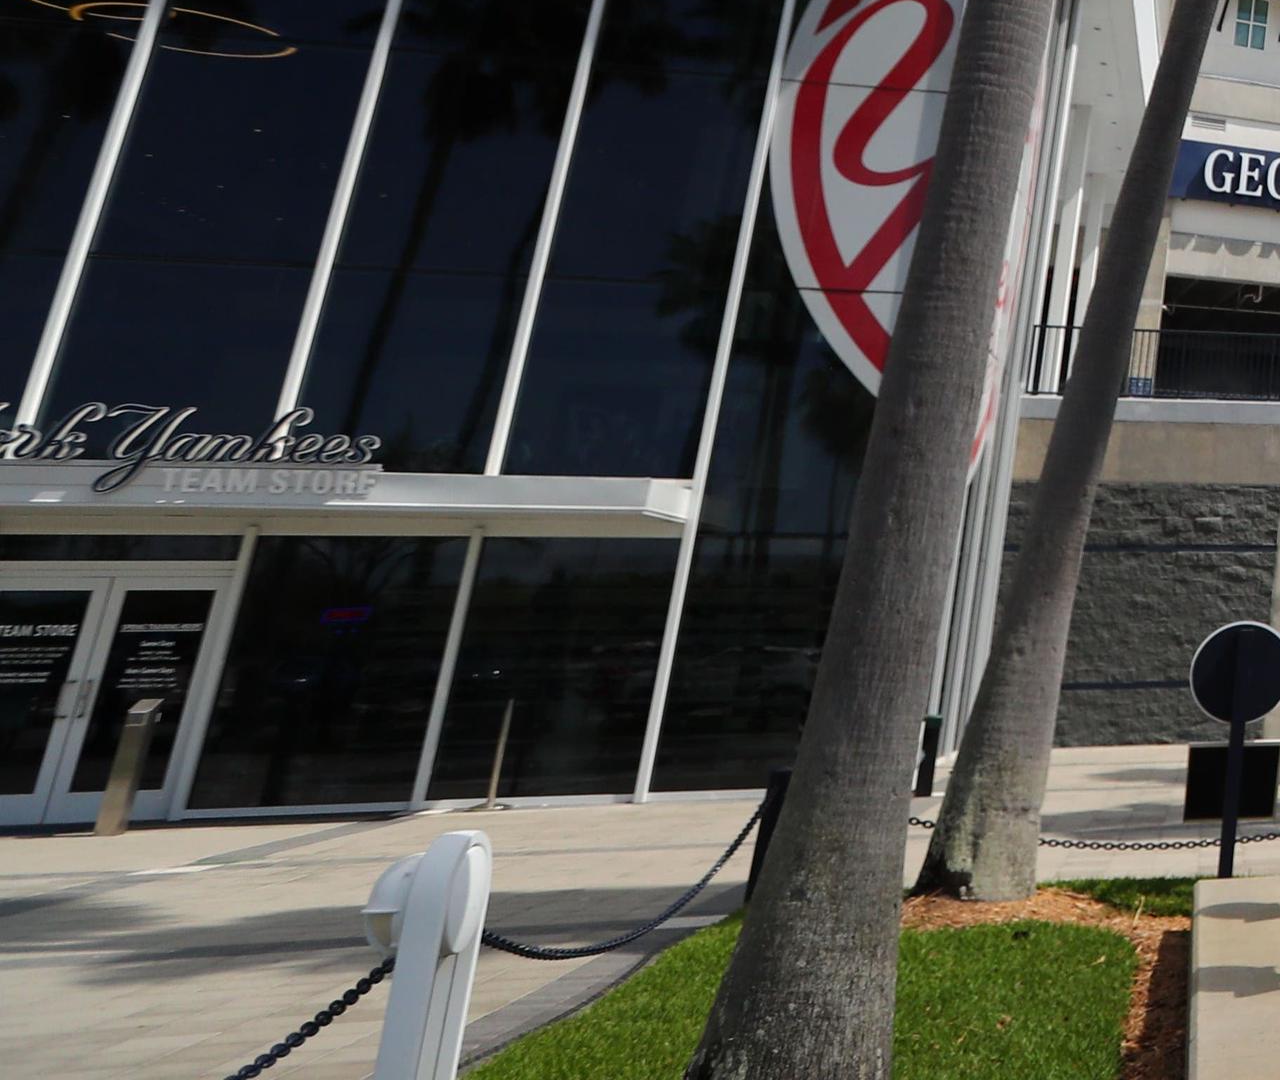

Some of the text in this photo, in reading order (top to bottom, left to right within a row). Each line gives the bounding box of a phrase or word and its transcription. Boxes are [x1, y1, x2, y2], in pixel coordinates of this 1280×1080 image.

[92, 402, 382, 494] Yankees
[161, 468, 378, 497] TEAM STORE
[33, 624, 79, 637] STORE
